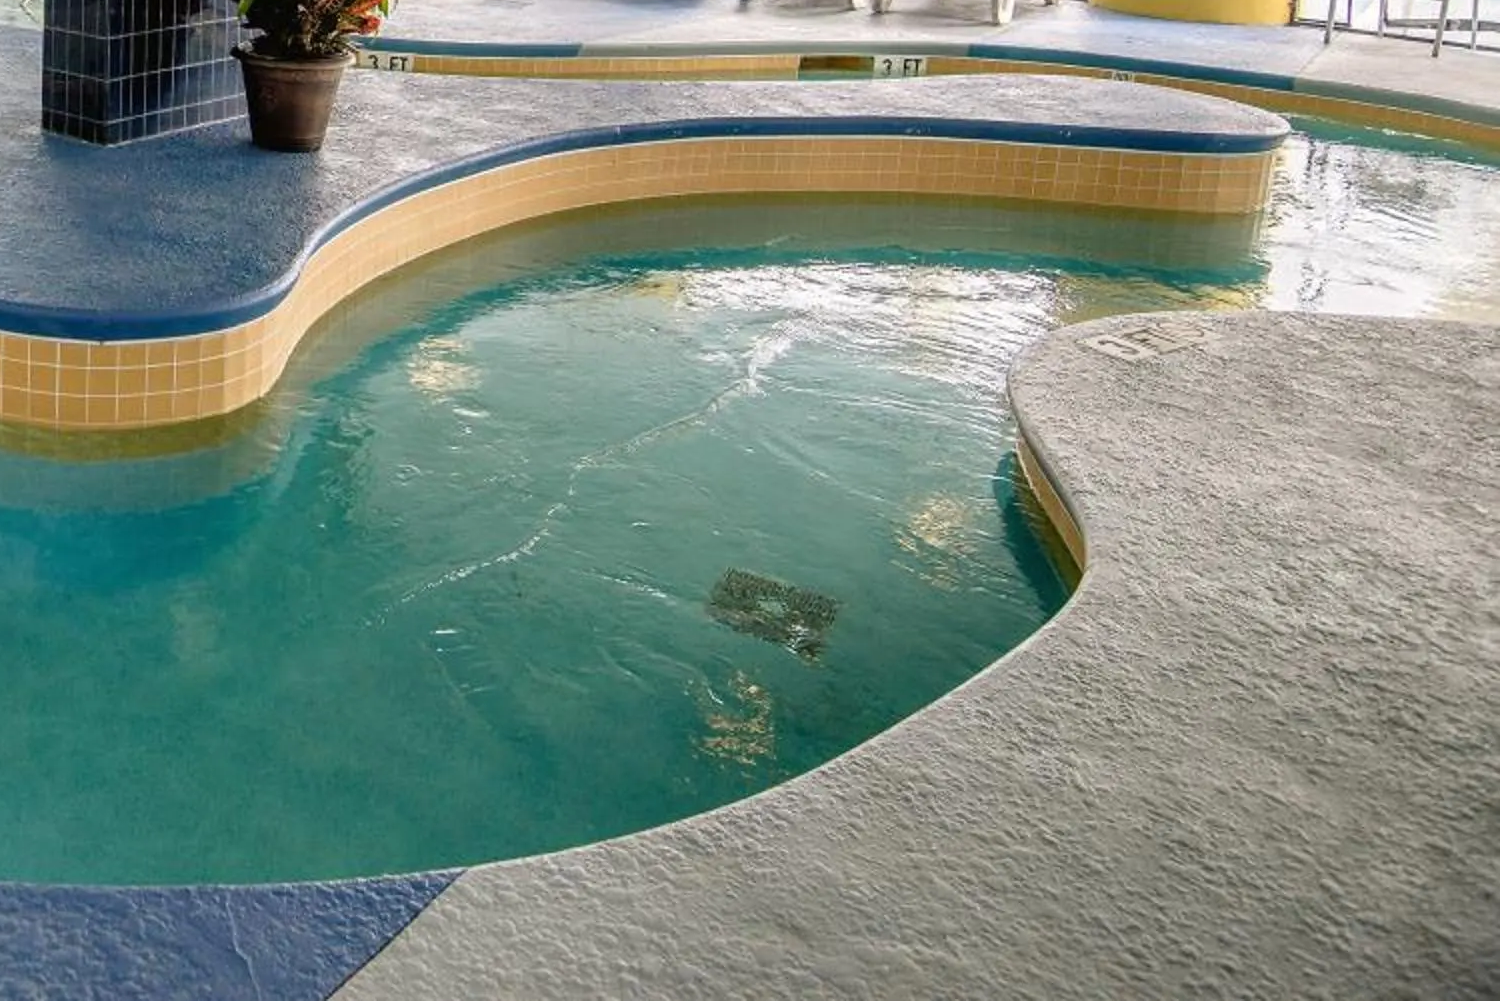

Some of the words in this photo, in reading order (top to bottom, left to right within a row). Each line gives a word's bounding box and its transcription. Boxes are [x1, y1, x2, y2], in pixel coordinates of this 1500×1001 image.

[367, 54, 379, 70] 3
[389, 55, 408, 72] FT
[881, 57, 893, 76] 3
[903, 57, 923, 77] FT
